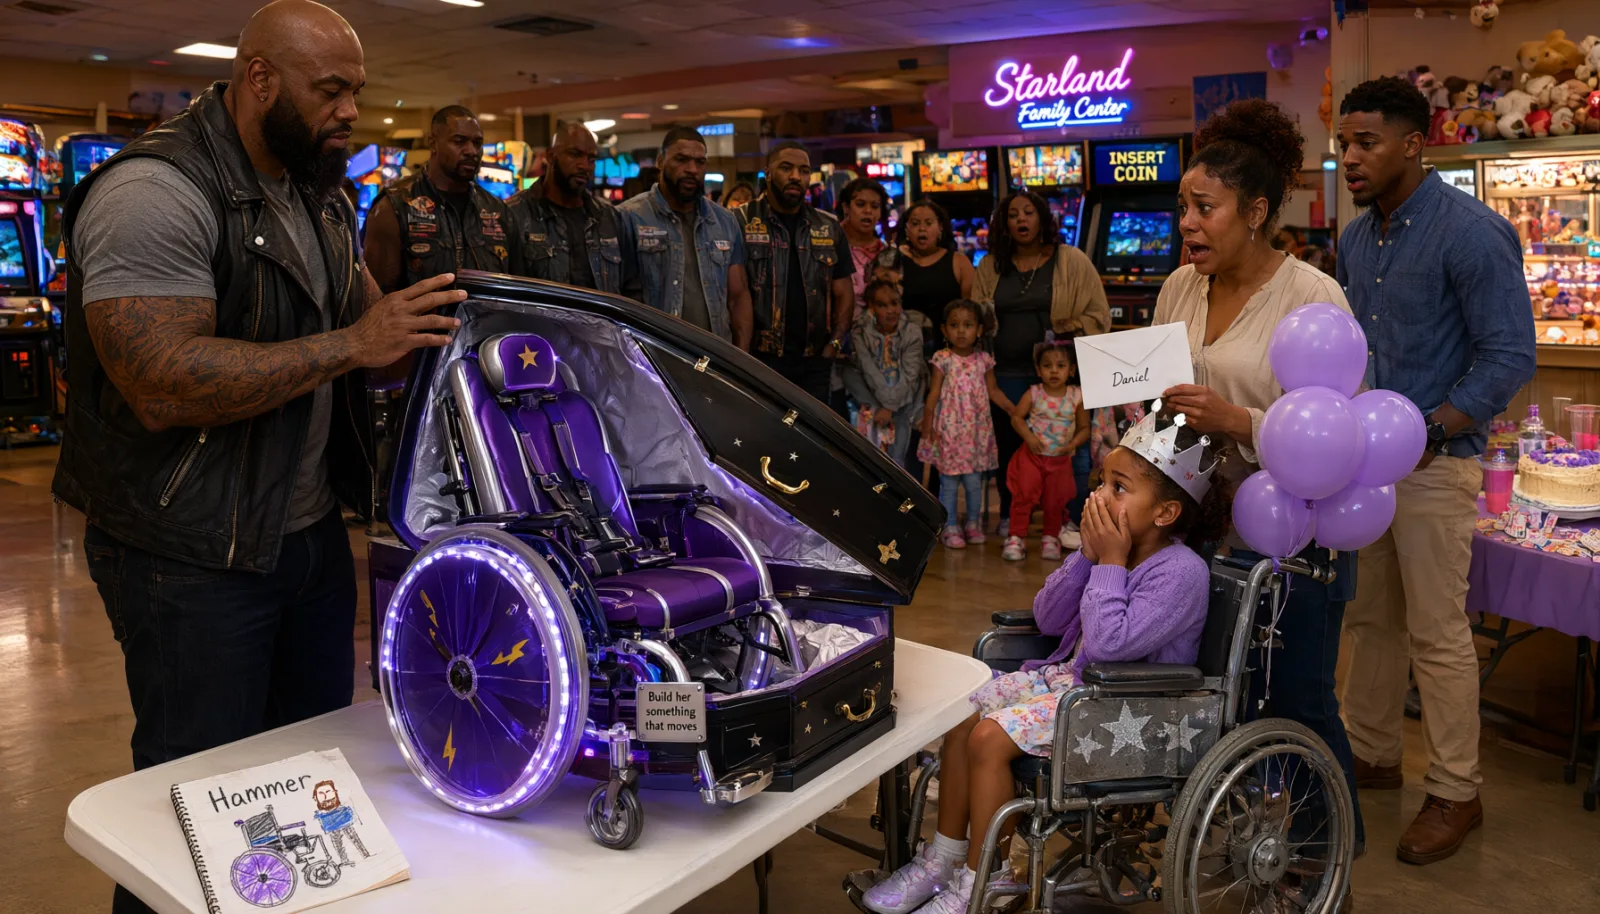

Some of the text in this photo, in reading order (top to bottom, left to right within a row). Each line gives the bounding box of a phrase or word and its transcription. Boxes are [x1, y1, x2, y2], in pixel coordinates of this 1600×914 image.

[984, 47, 1133, 107] Starland
[1018, 95, 1128, 127] Family Center
[1109, 151, 1166, 165] INSERT
[1113, 166, 1158, 182] COIN
[1112, 367, 1150, 387] Daniel
[648, 691, 692, 702] Build her
[646, 706, 696, 719] something
[645, 720, 698, 731] that moves
[208, 774, 312, 813] Hammer
